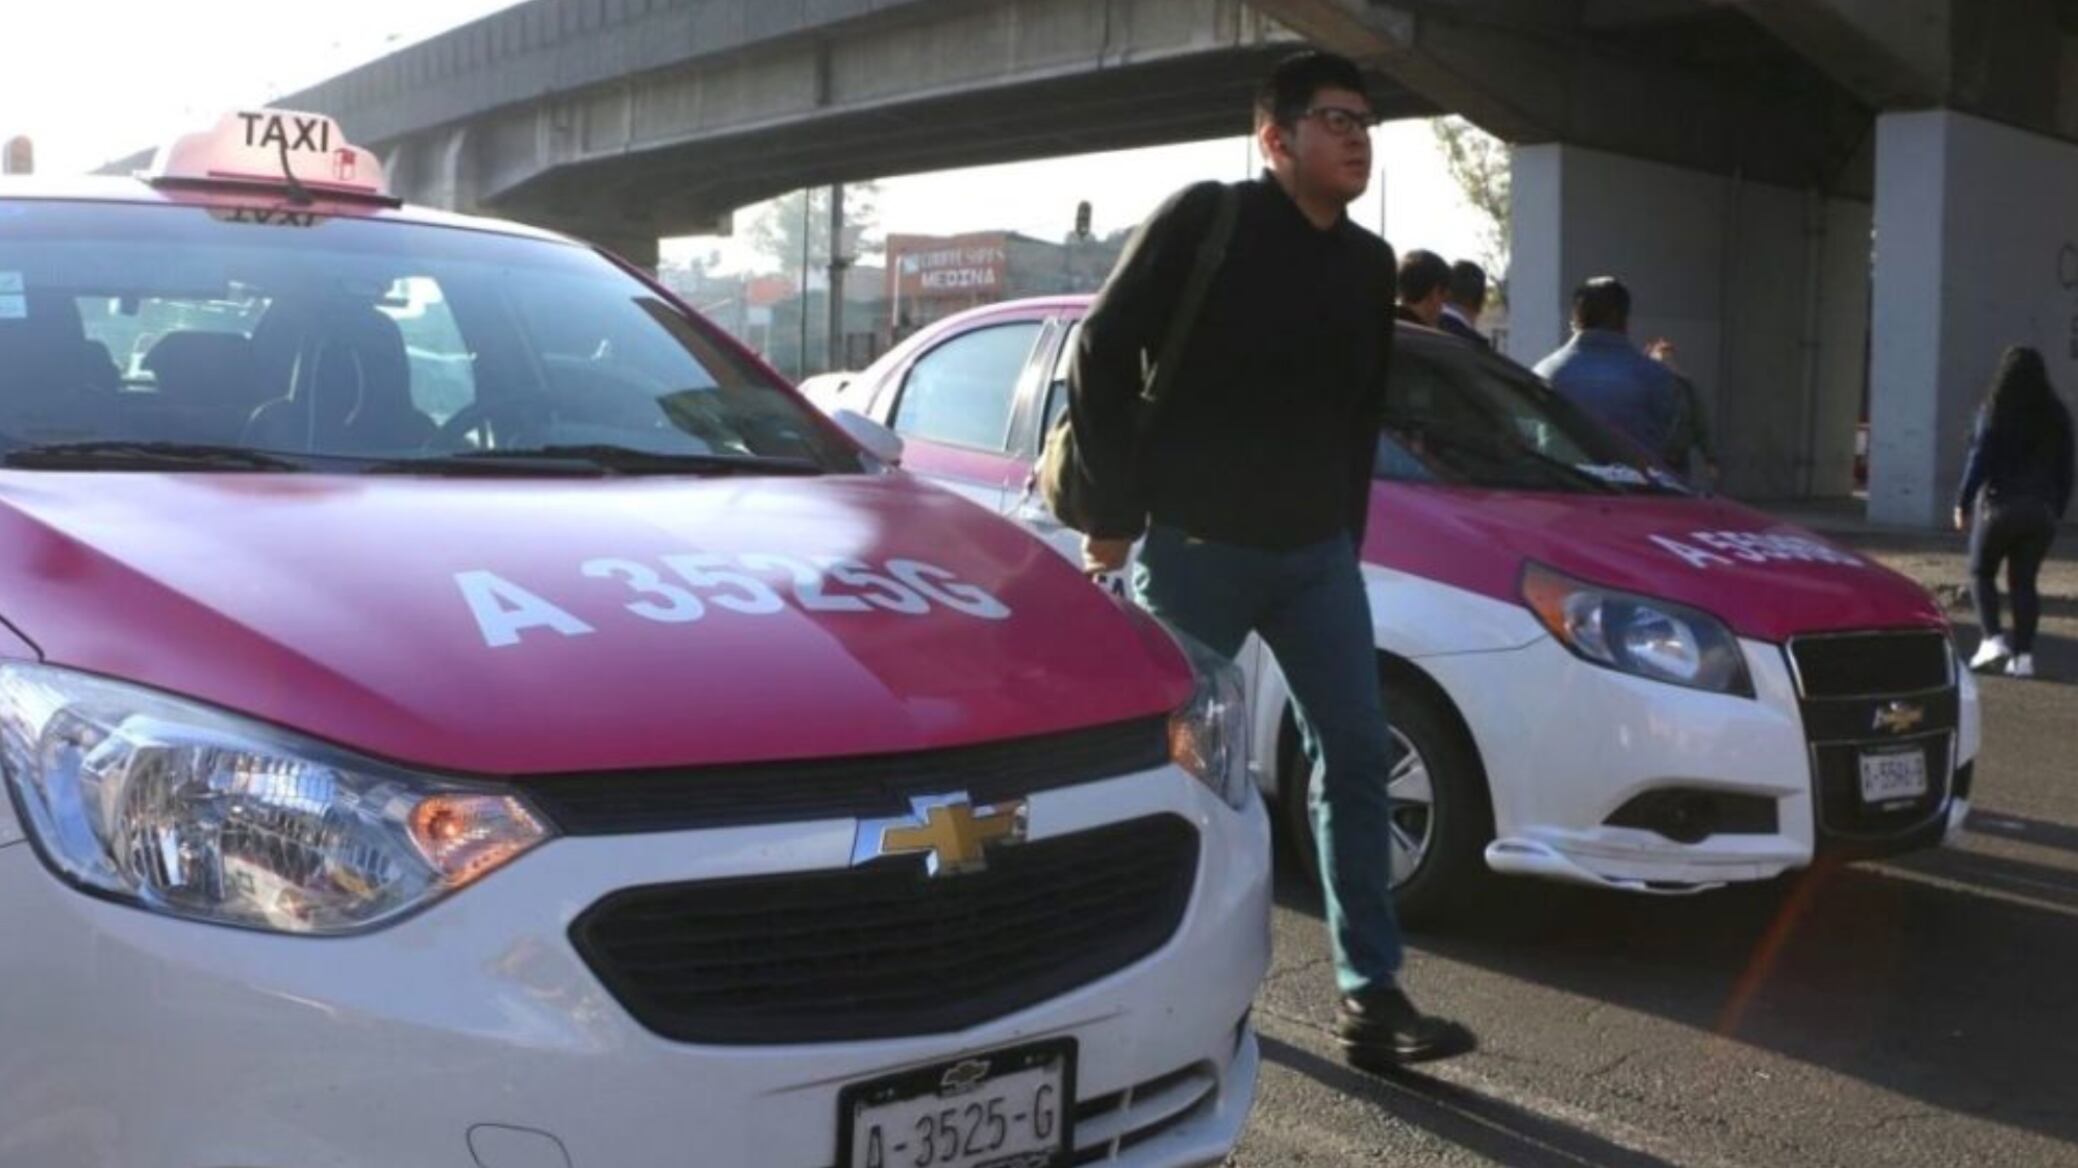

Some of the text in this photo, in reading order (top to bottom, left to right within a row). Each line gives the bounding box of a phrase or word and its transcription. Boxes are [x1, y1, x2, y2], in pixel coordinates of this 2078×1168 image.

[237, 111, 329, 152] TAXI
[454, 553, 1012, 647] A 3525G
[867, 1083, 1054, 1168] A-3525-G
